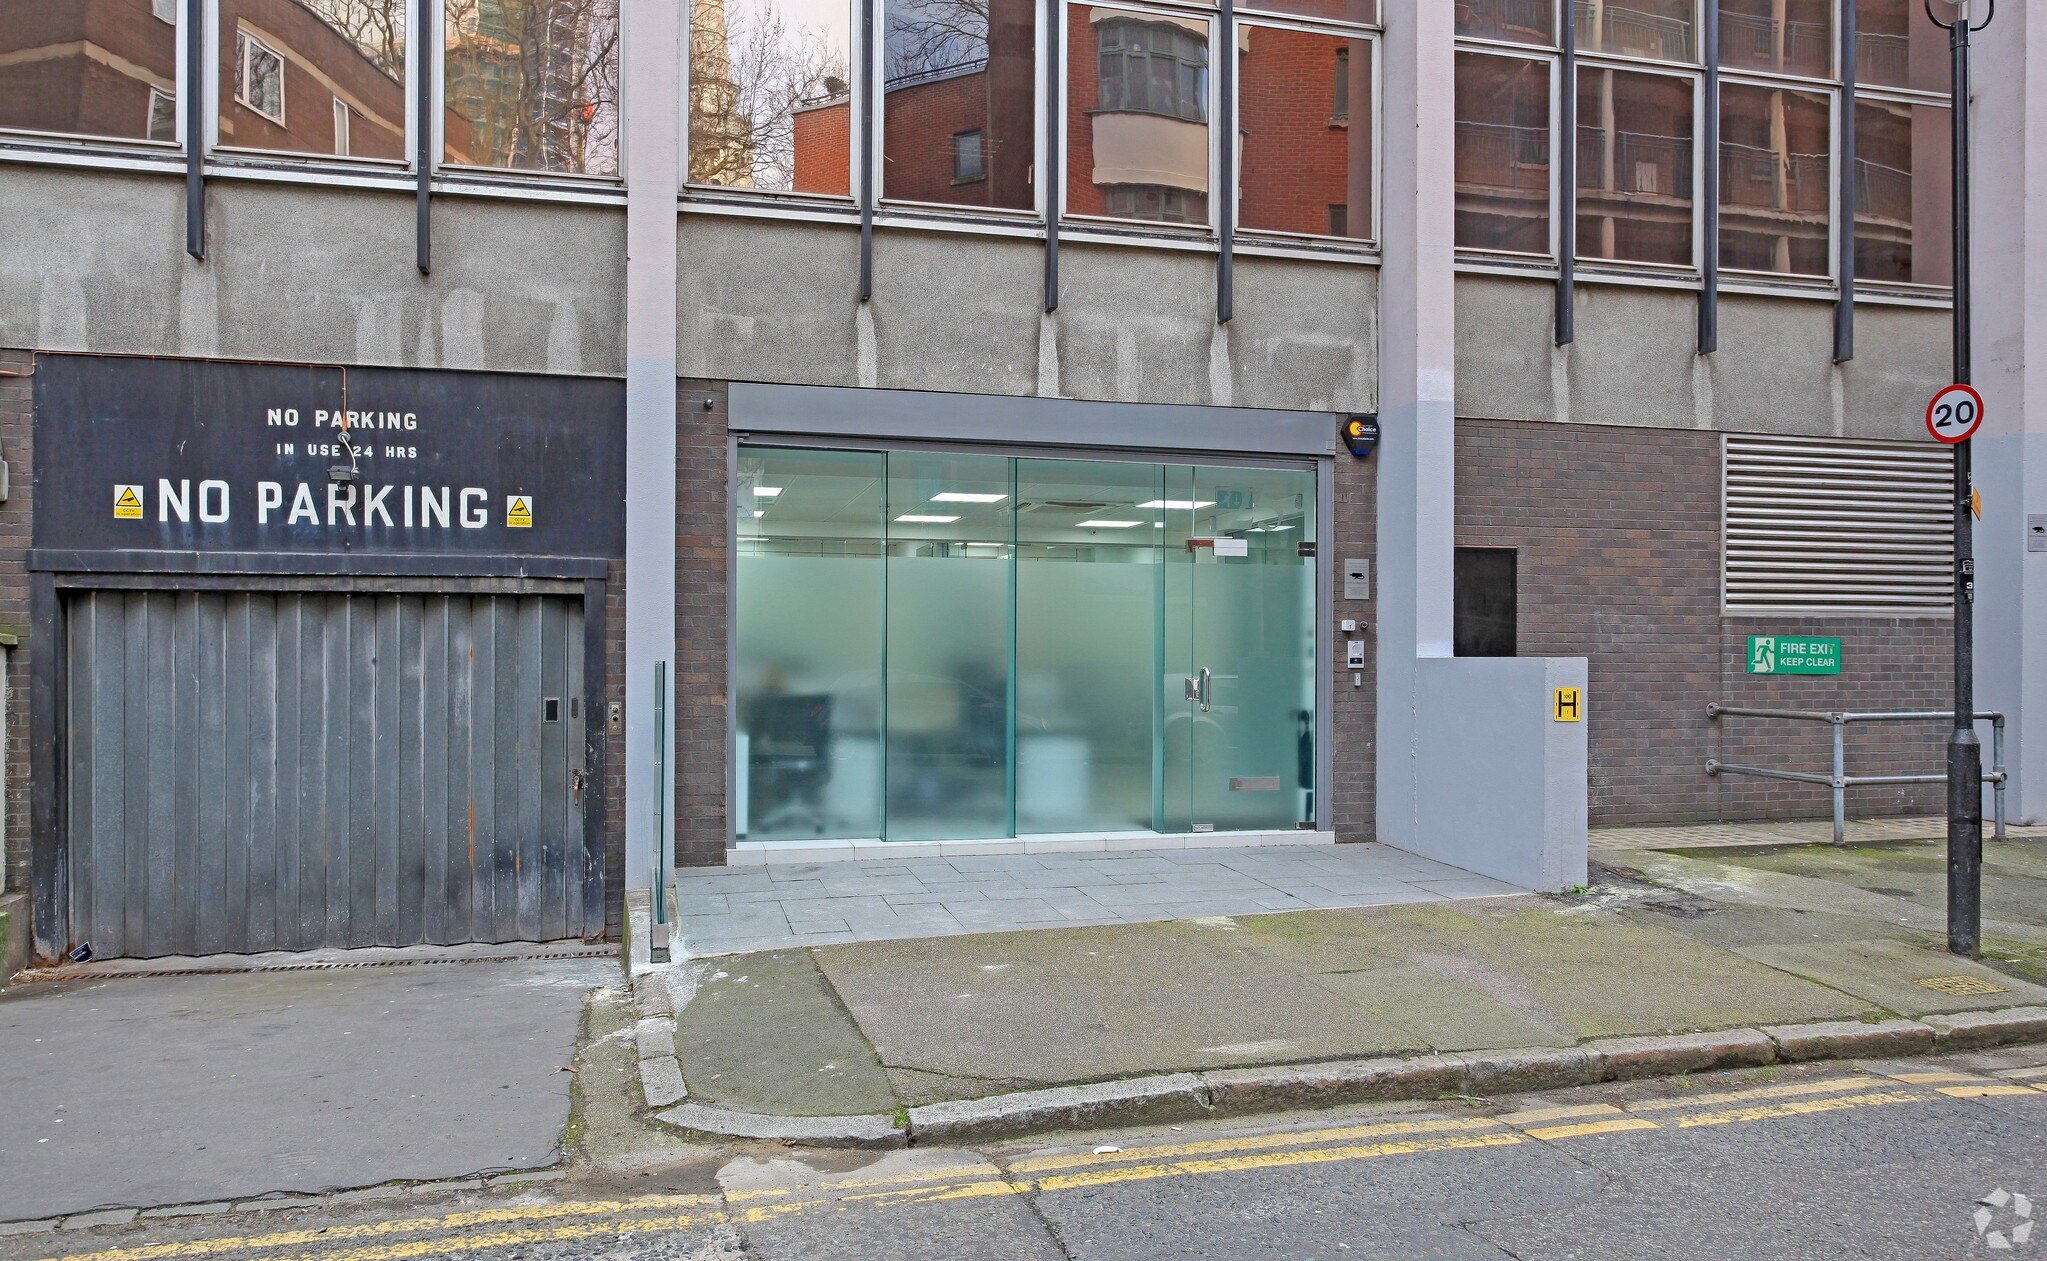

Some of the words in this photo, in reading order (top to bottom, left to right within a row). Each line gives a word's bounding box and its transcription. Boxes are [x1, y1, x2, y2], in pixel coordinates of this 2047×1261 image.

[267, 408, 299, 426] NO
[315, 410, 417, 430] PARKING
[1935, 400, 1974, 428] 20
[276, 443, 294, 455] IN
[308, 444, 341, 457] USE
[353, 446, 374, 457] 24
[385, 446, 417, 458] HRS
[158, 478, 230, 523] NO
[257, 481, 488, 529] PARKING
[1780, 643, 1807, 654] FIRE
[1780, 658, 1804, 666] KEEP
[1806, 658, 1835, 666] CLEAR
[1558, 691, 1576, 717] H
